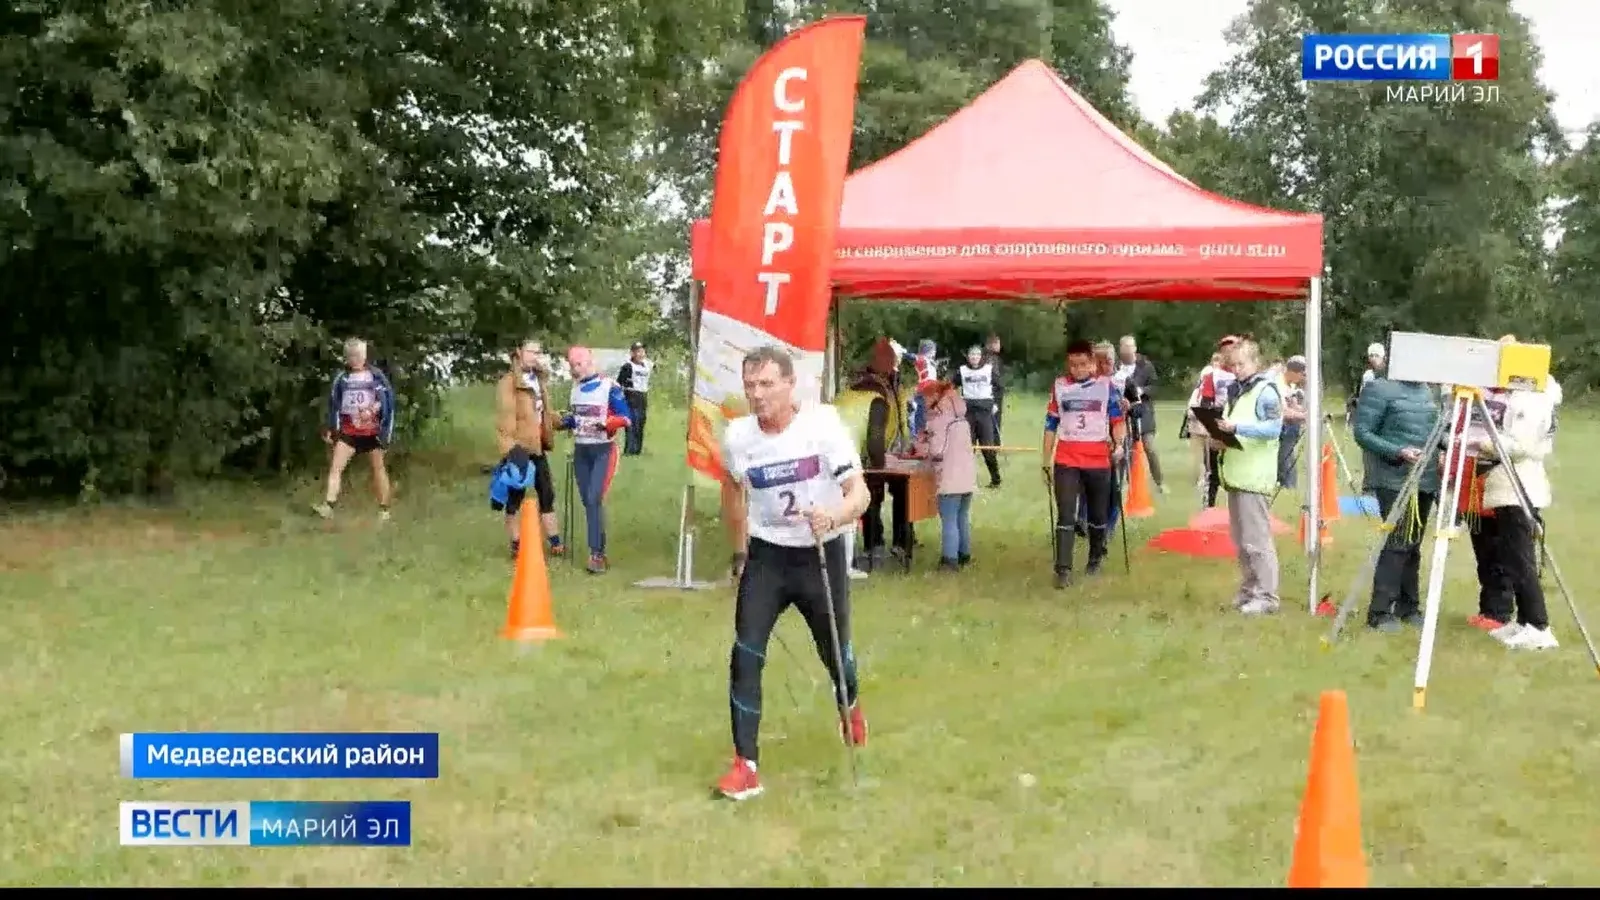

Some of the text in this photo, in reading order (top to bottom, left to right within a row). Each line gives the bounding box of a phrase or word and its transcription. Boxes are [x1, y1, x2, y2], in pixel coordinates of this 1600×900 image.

[757, 67, 808, 316] СТАРТ
[960, 243, 991, 257] для
[994, 242, 1107, 260] спортивного
[1077, 413, 1086, 430] 3
[779, 490, 799, 517] 2
